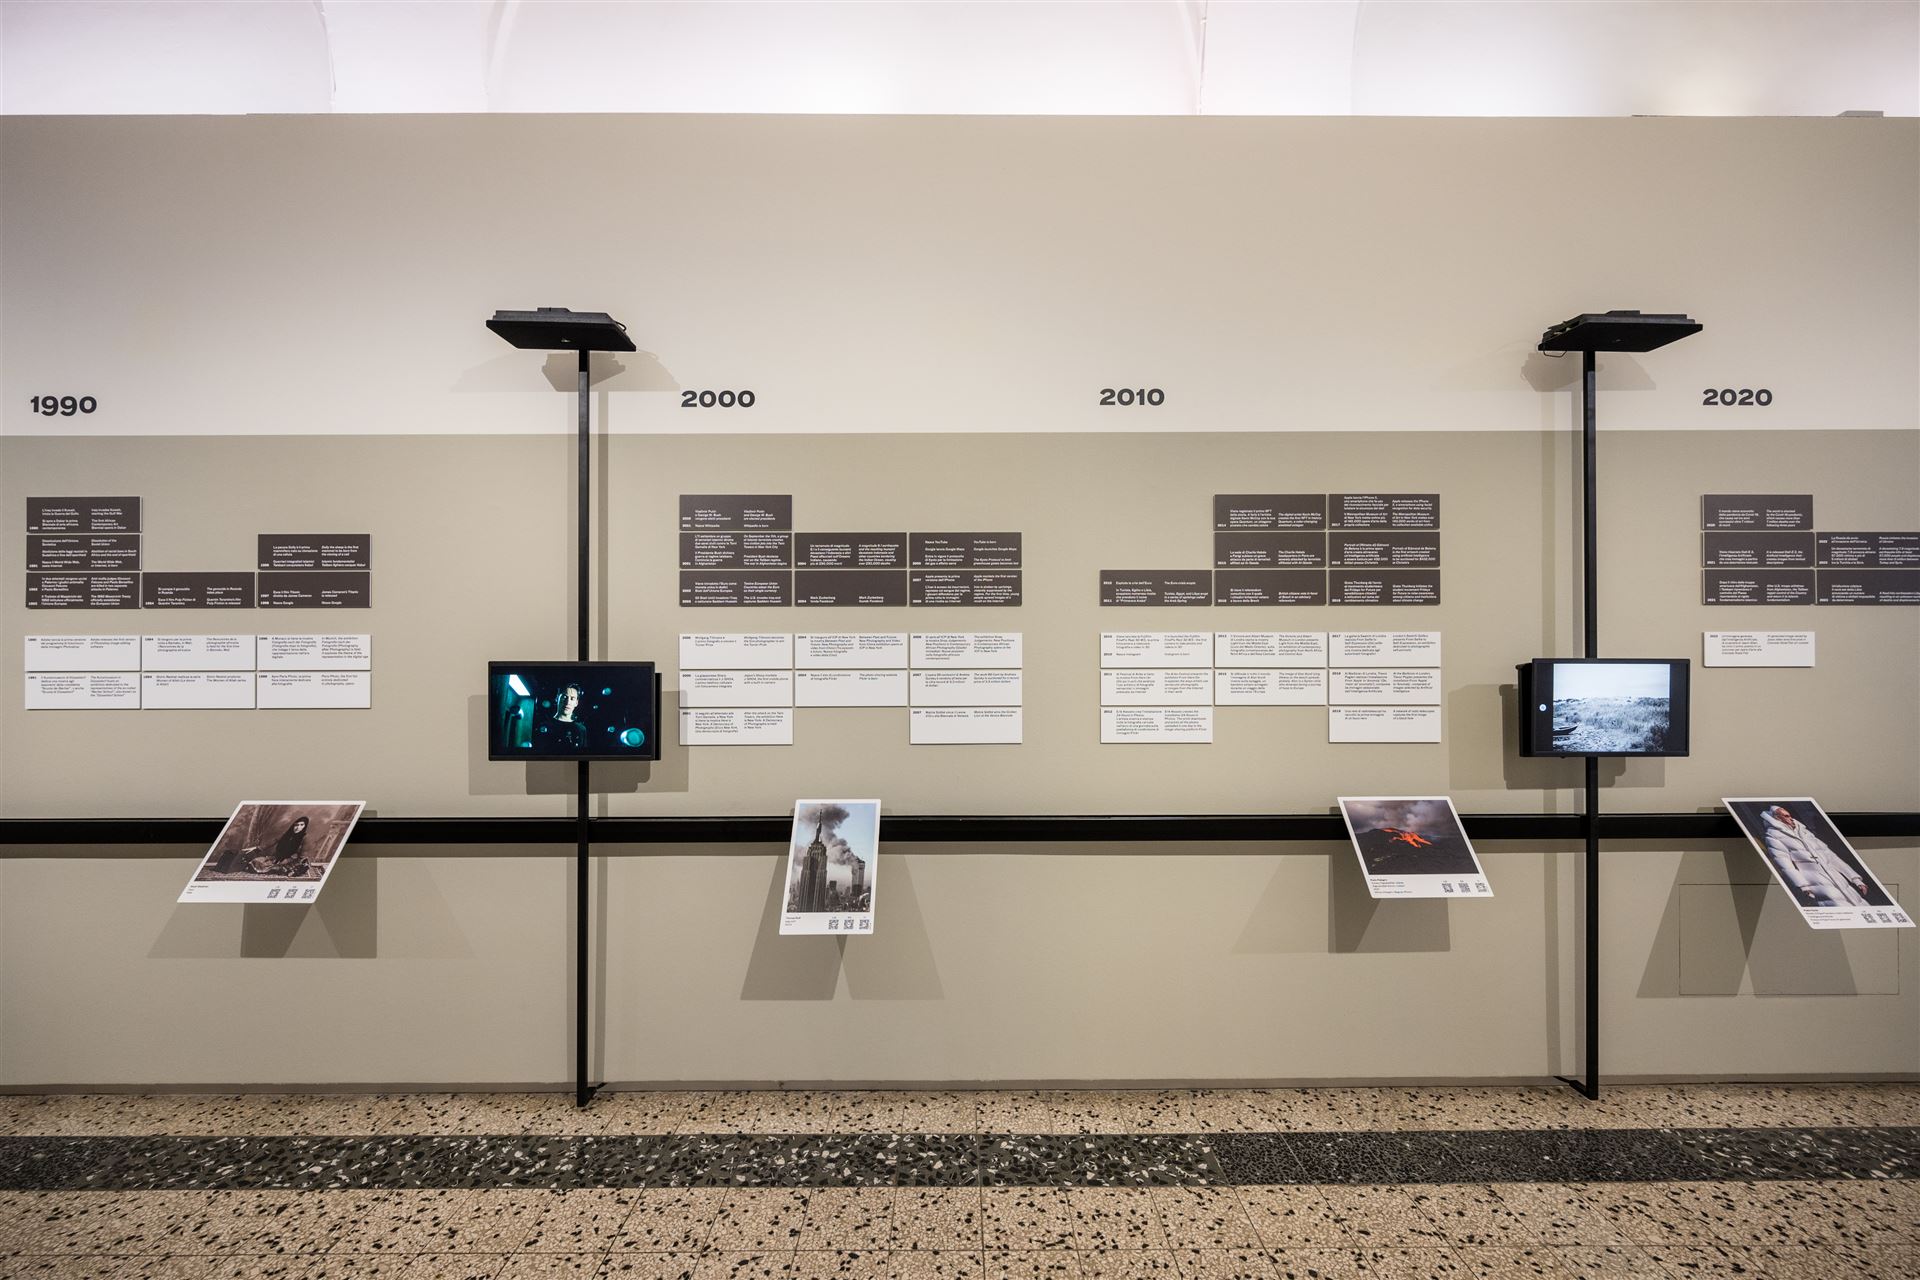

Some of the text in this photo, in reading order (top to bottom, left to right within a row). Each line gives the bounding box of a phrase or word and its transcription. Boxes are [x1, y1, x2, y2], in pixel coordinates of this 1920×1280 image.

[682, 391, 755, 407] 2000
[1100, 389, 1164, 405] 2010
[1703, 389, 1772, 406] 2020
[31, 396, 96, 416] 1990
